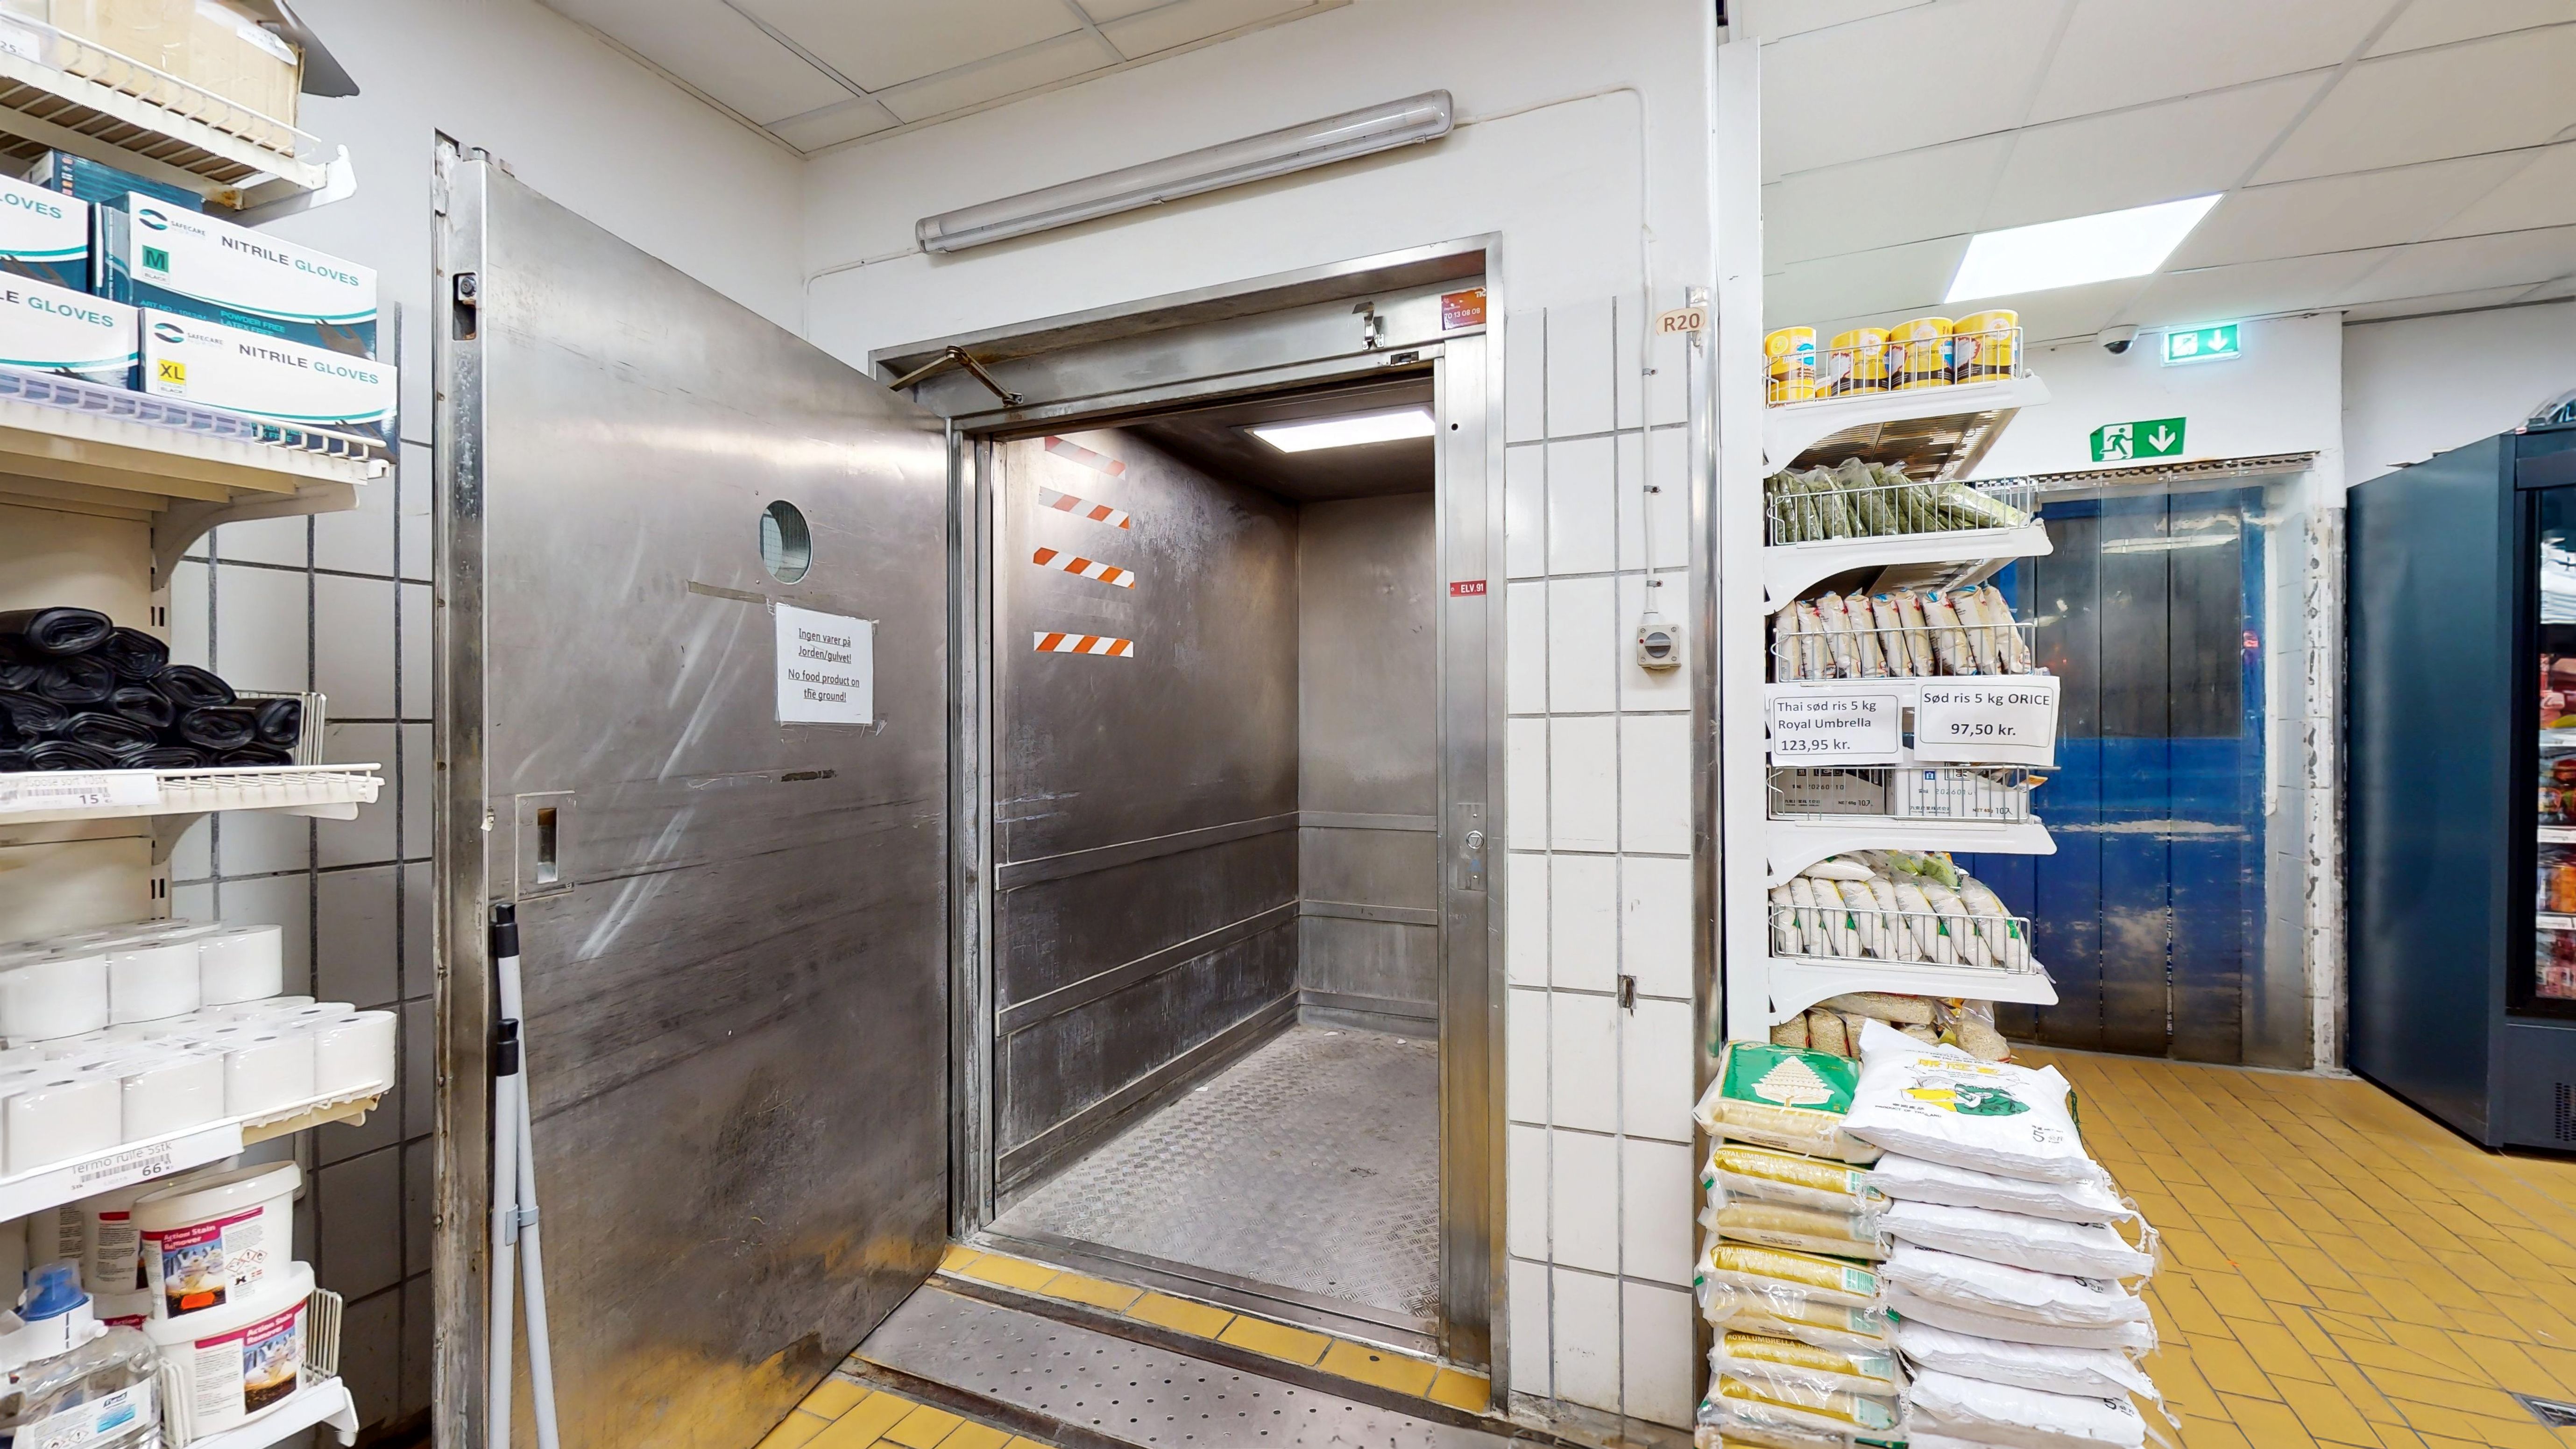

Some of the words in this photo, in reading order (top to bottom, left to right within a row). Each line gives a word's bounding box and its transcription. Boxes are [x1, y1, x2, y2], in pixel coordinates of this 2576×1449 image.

[0, 193, 62, 219] OVES
[171, 221, 205, 236] SAFECARE
[146, 250, 165, 269] M
[222, 235, 289, 266] NITRILE
[295, 260, 359, 286] GLOVES
[145, 273, 166, 282] BLACK
[28, 297, 113, 327] GLOVES
[220, 310, 261, 327] POWDER
[263, 321, 285, 333] FREE
[220, 319, 250, 332] LATEX
[1663, 313, 1700, 332] R20
[187, 333, 224, 345] SAFECARE
[239, 344, 308, 368] NITRILE
[314, 361, 379, 384] GLOVES
[160, 363, 184, 381] XL
[799, 628, 821, 642] Ingen
[823, 634, 841, 644] varer
[842, 636, 851, 647] på
[799, 646, 852, 662] Jorden/gulvet!
[788, 669, 800, 679] No
[802, 670, 820, 682] food
[822, 673, 849, 685] product
[804, 688, 816, 699] the
[818, 692, 846, 702] ground!
[1924, 693, 1949, 704] Sød
[1954, 693, 1970, 703] ris
[1974, 693, 1982, 703] 5
[1988, 693, 2003, 706] kg
[2008, 694, 2050, 706] ORICE
[1777, 702, 1803, 711] Thai
[1807, 701, 1828, 712] sød
[1833, 701, 1847, 710] ris
[1851, 701, 1858, 710] 5
[1862, 700, 1876, 712] kg
[1779, 719, 1811, 731] Royal
[1816, 718, 1871, 728] Umbrella
[1951, 724, 1993, 737] 97,50
[1998, 724, 2016, 735] kr.
[1782, 740, 1828, 752] 123,95
[1833, 739, 1850, 750] kr.
[79, 794, 99, 805] 15
[2032, 1130, 2045, 1142] 5
[1741, 1152, 1783, 1165] UMBRELLA
[142, 1162, 162, 1176] 66
[164, 1230, 191, 1242] Action
[191, 1225, 216, 1236] Stain
[164, 1236, 202, 1250] Remover
[1736, 1248, 1778, 1259] UMBRELLA
[246, 1322, 275, 1337] Action
[275, 1313, 293, 1325] Stain
[247, 1324, 284, 1345] Remover
[1752, 1336, 1795, 1348] UMBRELLA
[2103, 1398, 2117, 1410] 5
